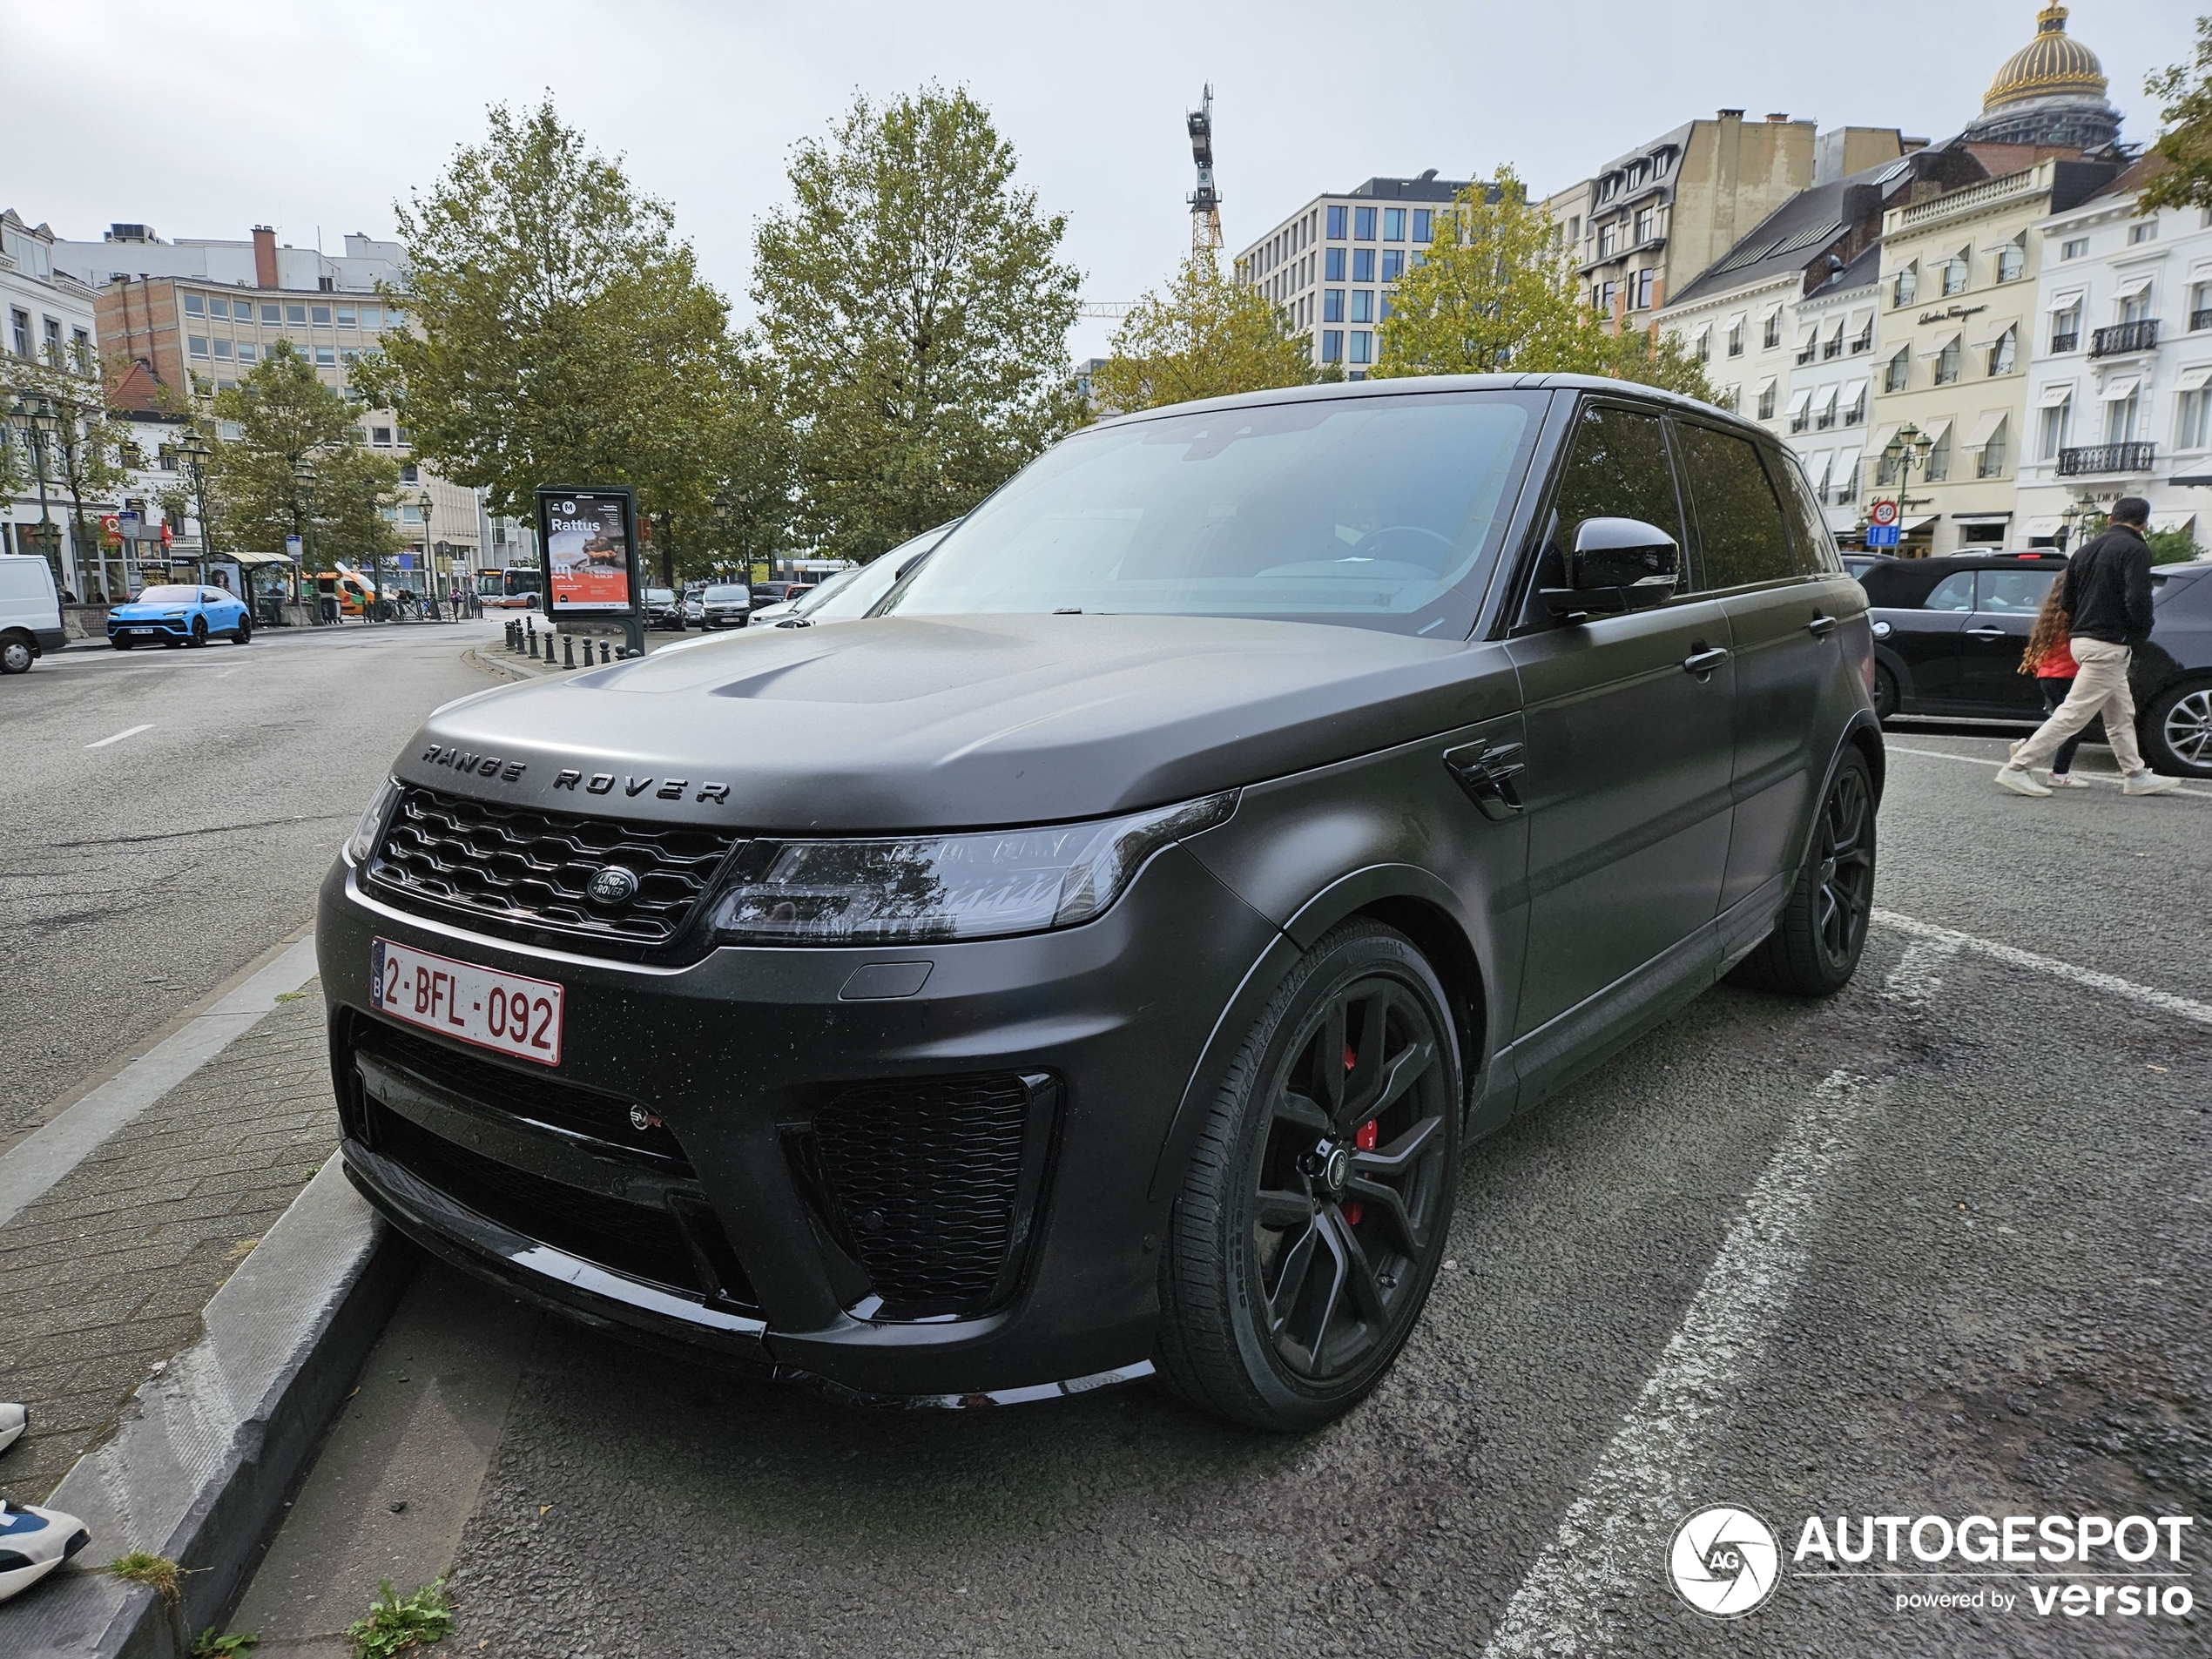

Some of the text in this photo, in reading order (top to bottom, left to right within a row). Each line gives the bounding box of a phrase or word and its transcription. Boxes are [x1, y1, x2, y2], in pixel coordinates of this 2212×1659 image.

[2097, 492, 2123, 503] DIOR
[1878, 508, 1892, 516] 50
[551, 518, 601, 532] Rattus
[421, 743, 732, 806] RANGE ROVER
[597, 874, 621, 887] LAND
[596, 884, 624, 897] ROVER
[374, 976, 381, 998] B
[385, 957, 553, 1051] 2-BFL-092
